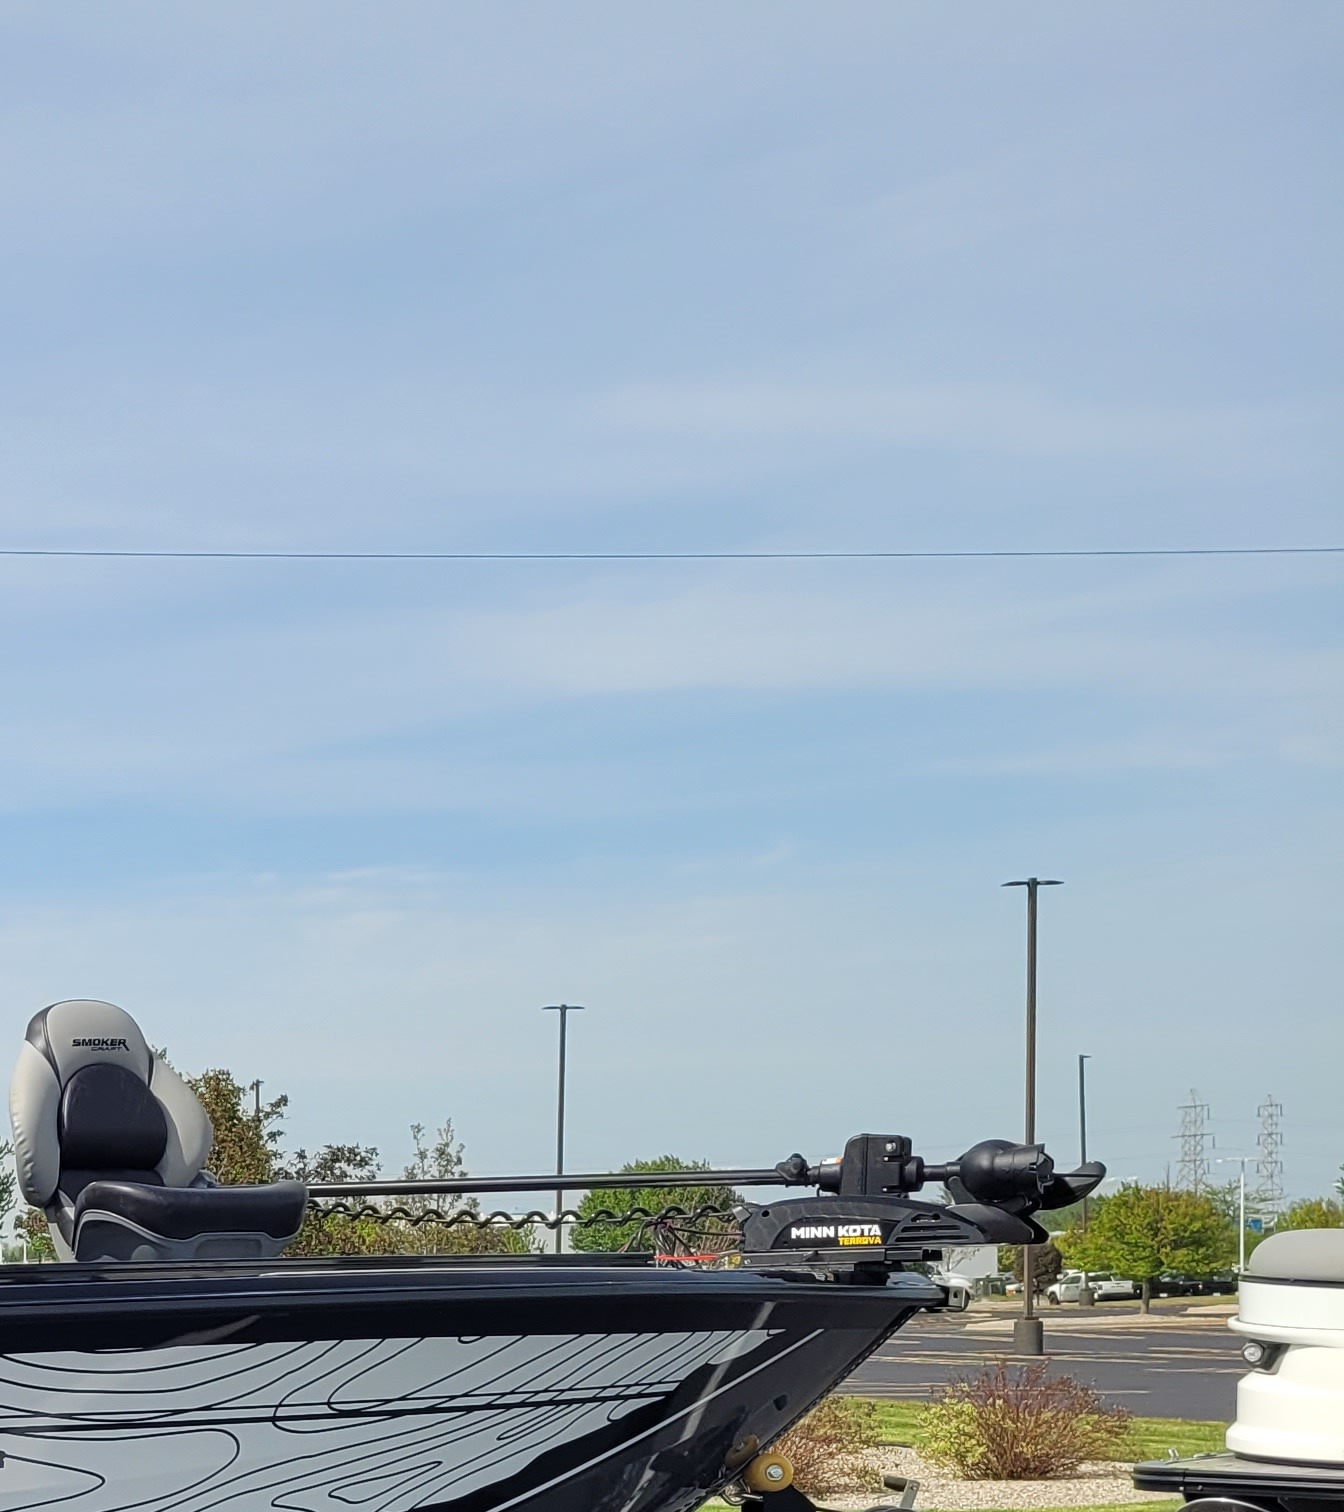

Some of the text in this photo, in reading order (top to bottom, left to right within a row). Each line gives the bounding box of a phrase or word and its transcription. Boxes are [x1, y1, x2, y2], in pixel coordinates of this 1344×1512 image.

[72, 1038, 130, 1052] SMOKER
[791, 1224, 882, 1239] MINN KOTA
[837, 1236, 882, 1246] TERROVA
